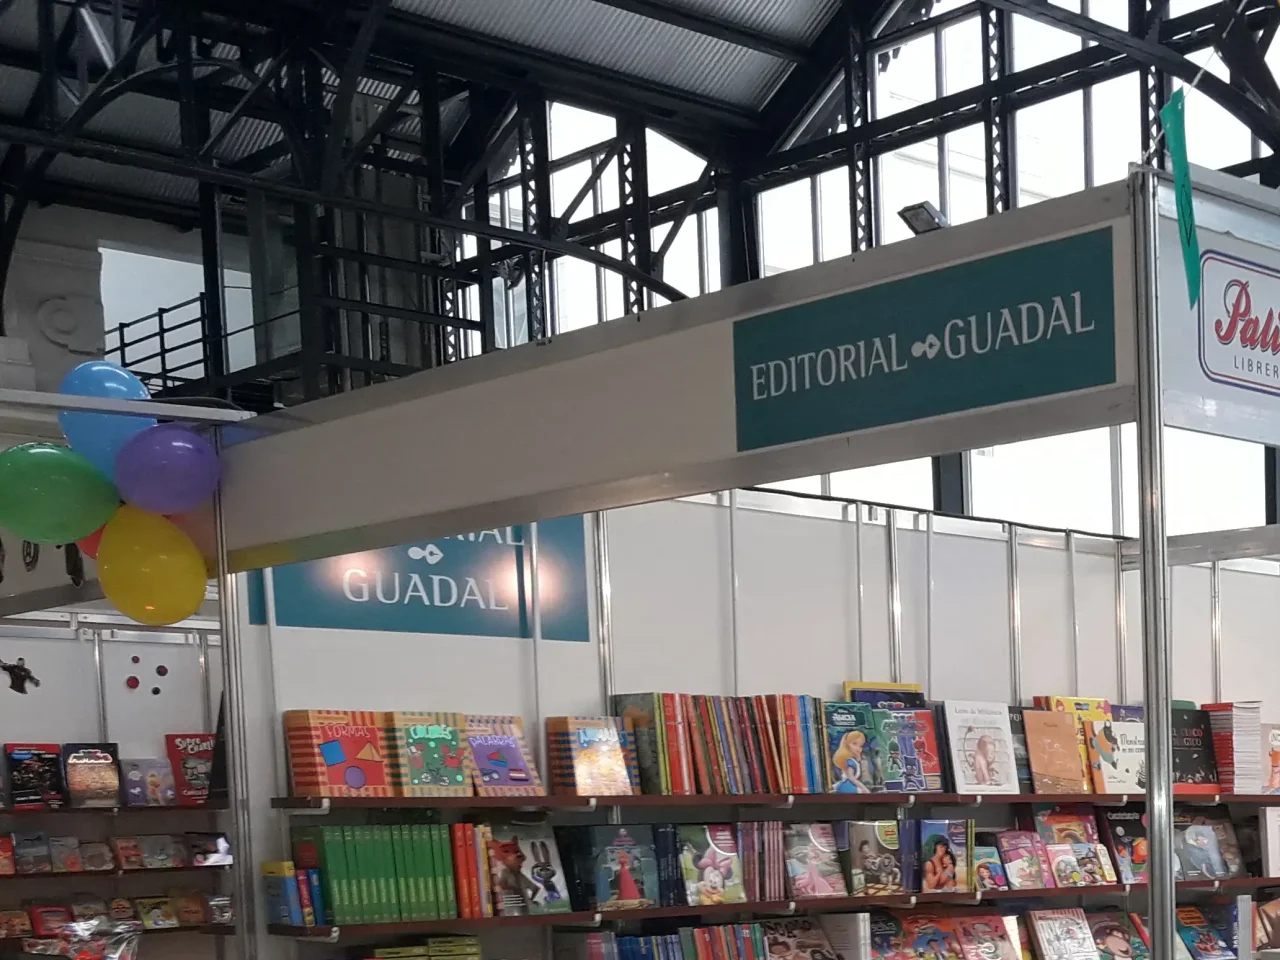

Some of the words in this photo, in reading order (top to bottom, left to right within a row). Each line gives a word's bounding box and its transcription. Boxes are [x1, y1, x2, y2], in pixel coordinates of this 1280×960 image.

[750, 333, 908, 401] EDITORIAL
[944, 290, 1095, 360] GUADAL
[342, 568, 509, 611] GUADAL
[326, 725, 372, 739] FORMAS
